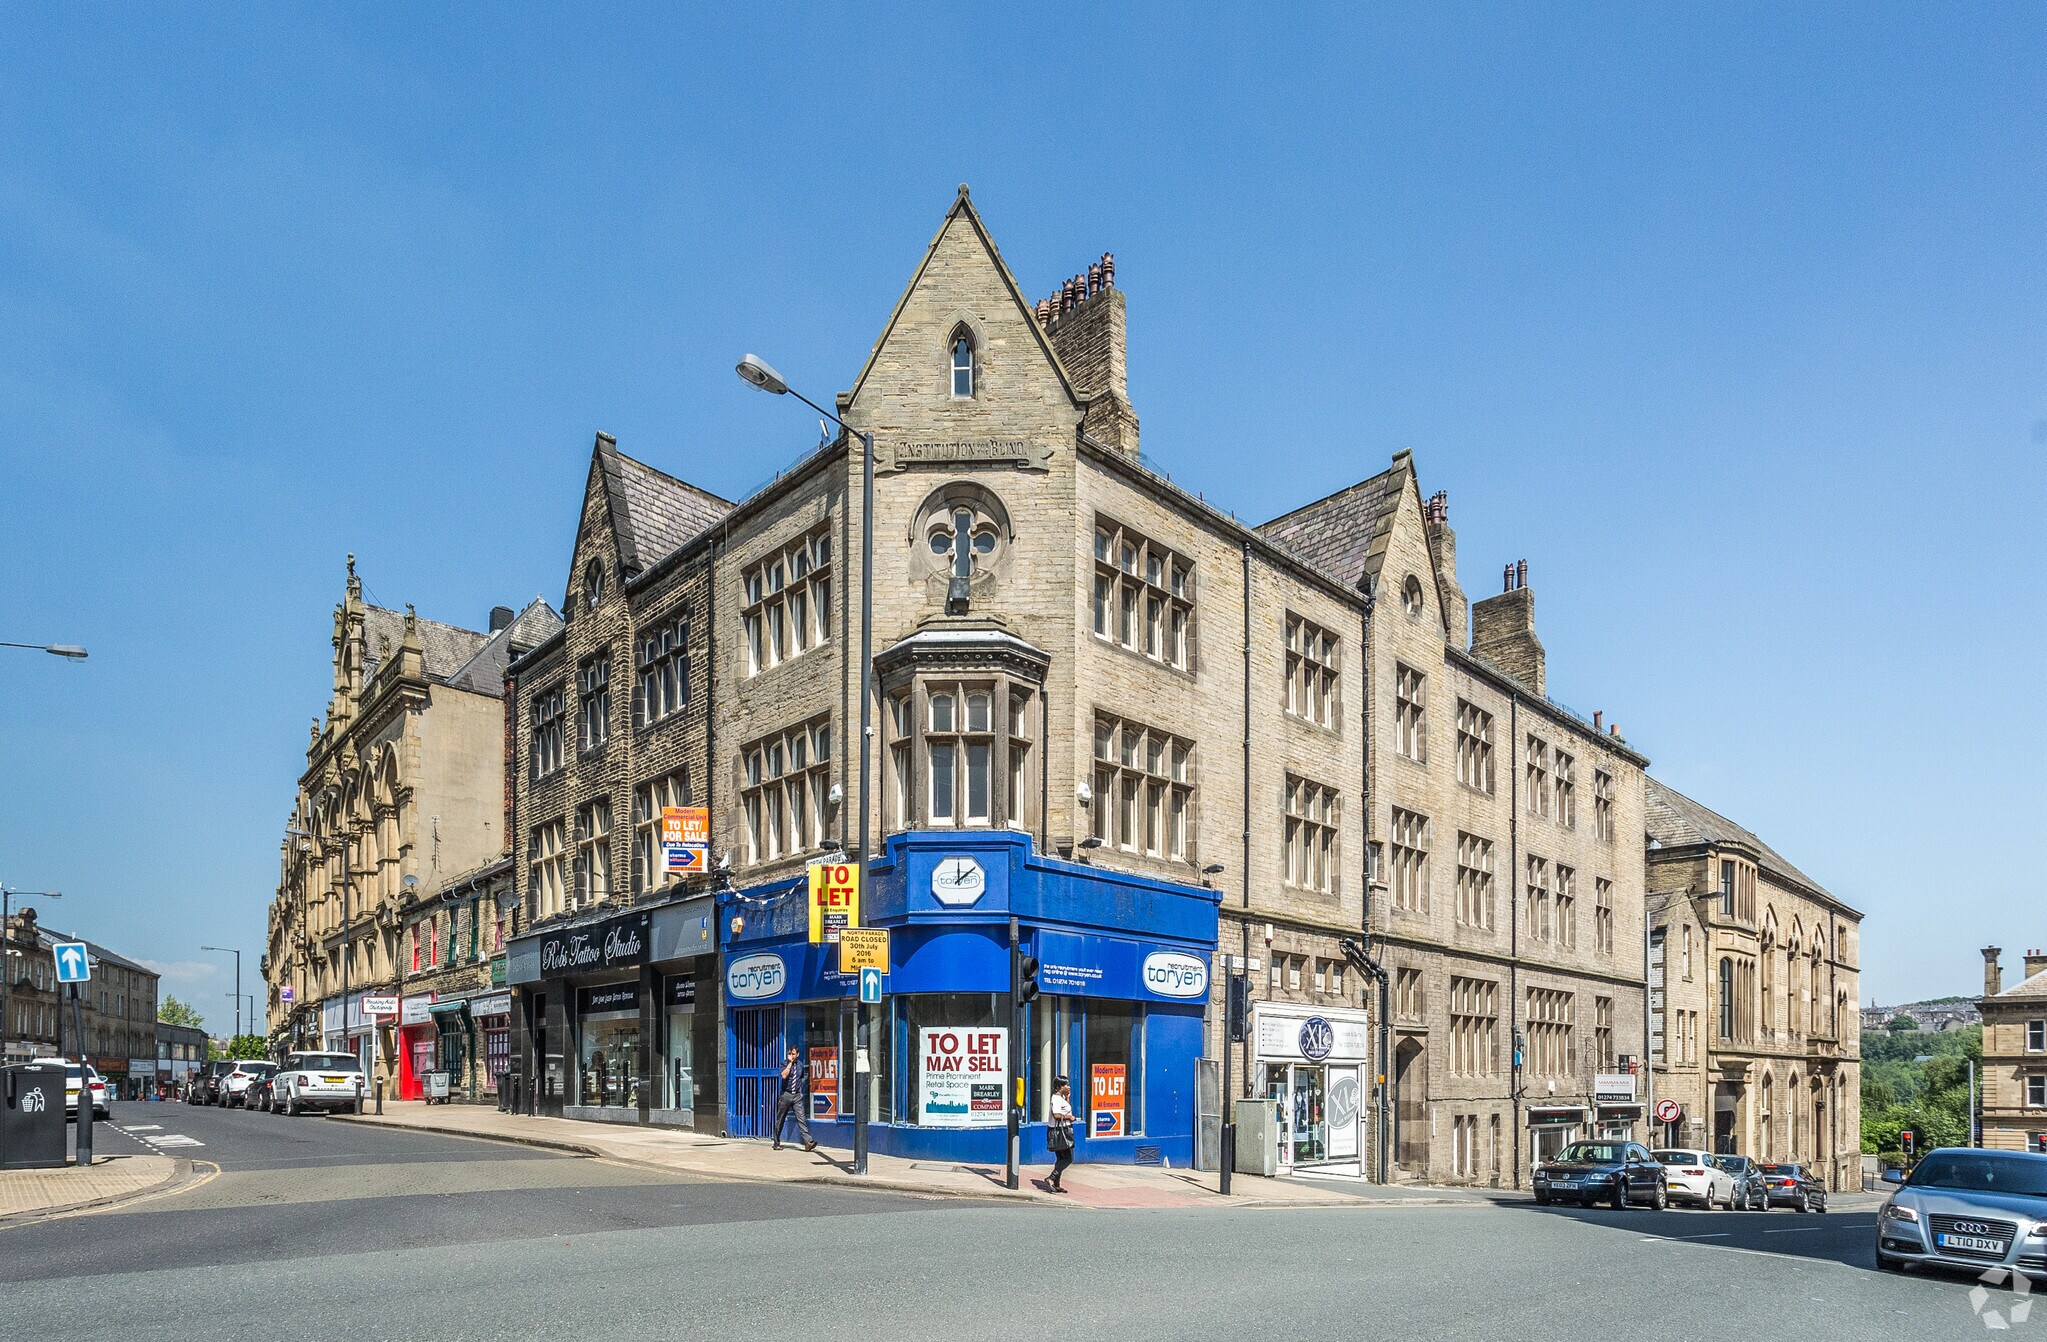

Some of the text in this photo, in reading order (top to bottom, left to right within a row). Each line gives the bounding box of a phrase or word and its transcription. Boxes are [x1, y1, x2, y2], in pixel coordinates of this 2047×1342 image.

[668, 820, 703, 832] TO LET/
[663, 831, 708, 842] FOR SALE
[822, 865, 849, 884] TO
[817, 888, 854, 906] LET
[542, 940, 569, 970] Robs
[569, 934, 600, 965] Tattoo
[604, 926, 642, 966] Studio
[747, 962, 781, 973] recruitment
[1167, 962, 1203, 973] recruitment
[731, 969, 783, 990] toryen
[1147, 965, 1204, 989] toryen
[928, 1033, 1001, 1055] TO LET
[811, 1060, 838, 1079] TO LET
[926, 1056, 1002, 1072] MAY SELL
[1095, 1066, 1124, 1074] Modern Unit
[926, 1072, 981, 1080] Prime Prominent
[946, 1081, 969, 1089] Space
[1093, 1076, 1125, 1096] TO LET
[1948, 1235, 1999, 1250] LT10 DXV
